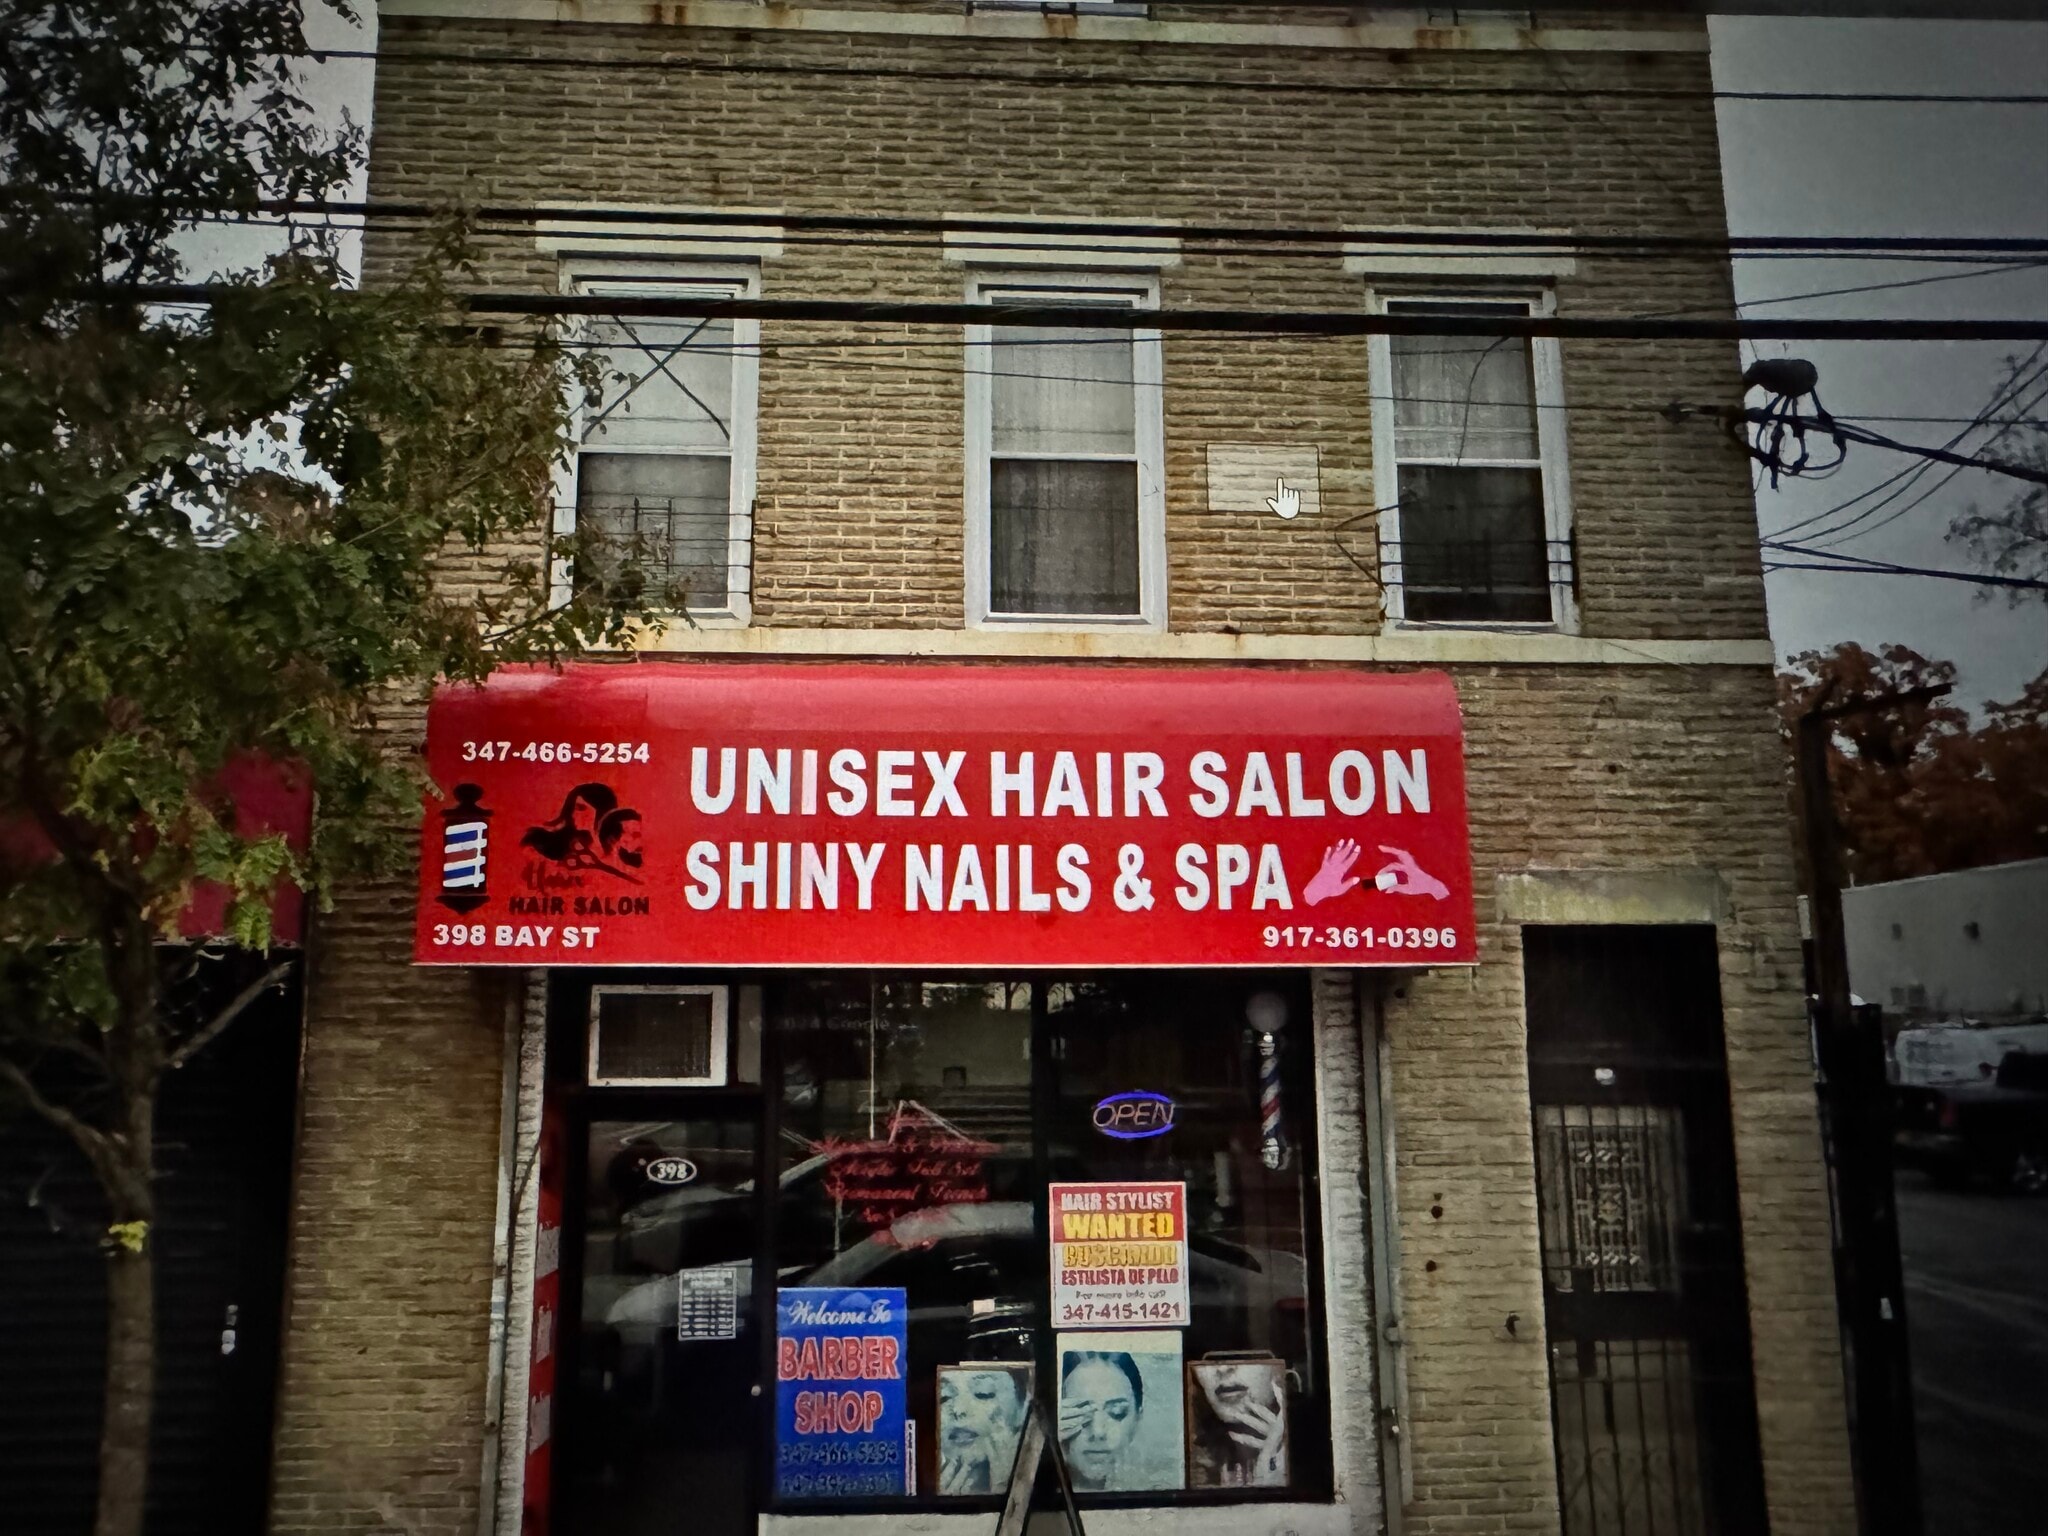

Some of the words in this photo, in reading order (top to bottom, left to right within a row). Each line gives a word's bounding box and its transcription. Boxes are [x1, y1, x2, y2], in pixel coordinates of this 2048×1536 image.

[462, 741, 650, 764] 347-466-5254
[690, 746, 968, 818] UNISEX
[990, 750, 1169, 818] HAIR
[1188, 748, 1431, 818] SALON
[684, 840, 887, 911] SHINY
[905, 843, 1092, 913] NAILS
[1112, 842, 1156, 912] &
[1174, 842, 1294, 912] SPA
[508, 896, 565, 916] HAIR
[573, 896, 649, 916] SALON
[432, 923, 486, 947] 398
[494, 925, 554, 947] BAY
[561, 926, 601, 948] ST
[1262, 925, 1457, 949] 917-361-0396
[1092, 1101, 1176, 1127] OPEN
[656, 1162, 688, 1180] 398
[1061, 1192, 1102, 1211] HAIR
[1106, 1191, 1174, 1210] STYLIST
[1062, 1212, 1174, 1240] WANTED
[1062, 1268, 1125, 1286] ESTILISTA
[1128, 1268, 1145, 1285] DE
[788, 1300, 866, 1325] Welcome
[866, 1299, 892, 1324] To
[1062, 1301, 1181, 1321] 347-415-1421
[777, 1336, 901, 1380] BARBER
[795, 1390, 884, 1434] SHOP
